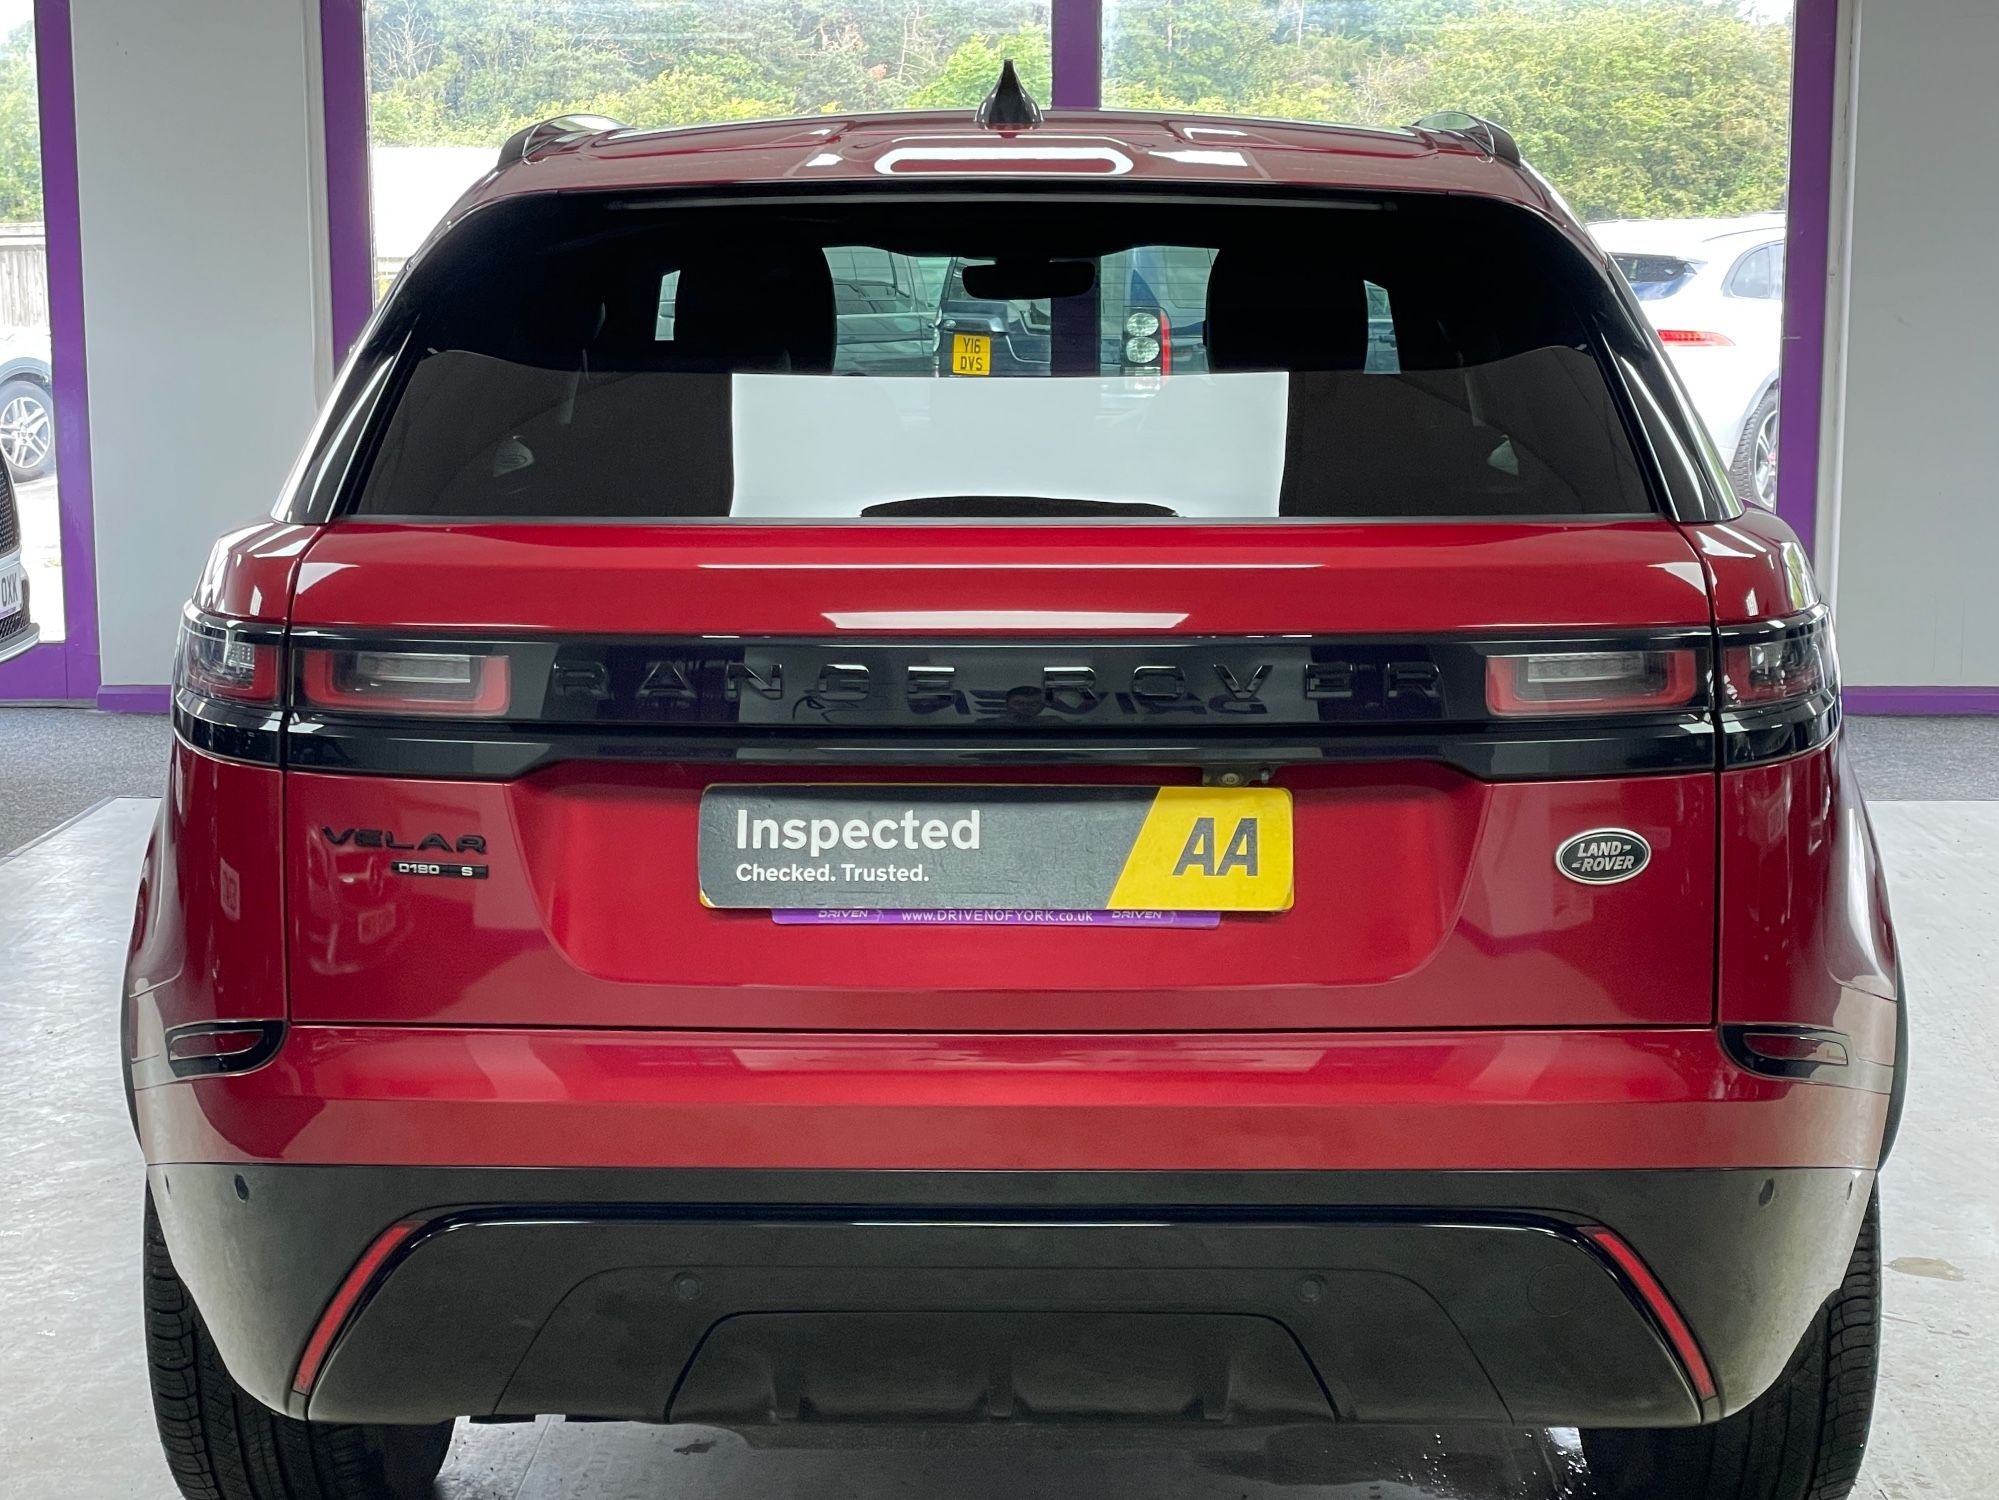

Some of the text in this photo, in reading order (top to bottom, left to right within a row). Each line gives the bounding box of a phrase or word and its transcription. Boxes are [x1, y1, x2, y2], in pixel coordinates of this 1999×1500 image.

[963, 337, 981, 354] Y16
[960, 356, 983, 371] DVS
[553, 661, 1445, 701] RANGE ROVER
[322, 826, 487, 855] VELAR
[737, 809, 981, 857] Inspected
[1172, 817, 1259, 877] AA
[461, 866, 474, 877] S
[736, 864, 930, 882] Checked. Trusted.
[818, 909, 868, 918] DRIVEN
[901, 910, 1094, 922] www.DRIVENOFYORK.co.uk
[1111, 911, 1162, 919] DRIVEN
